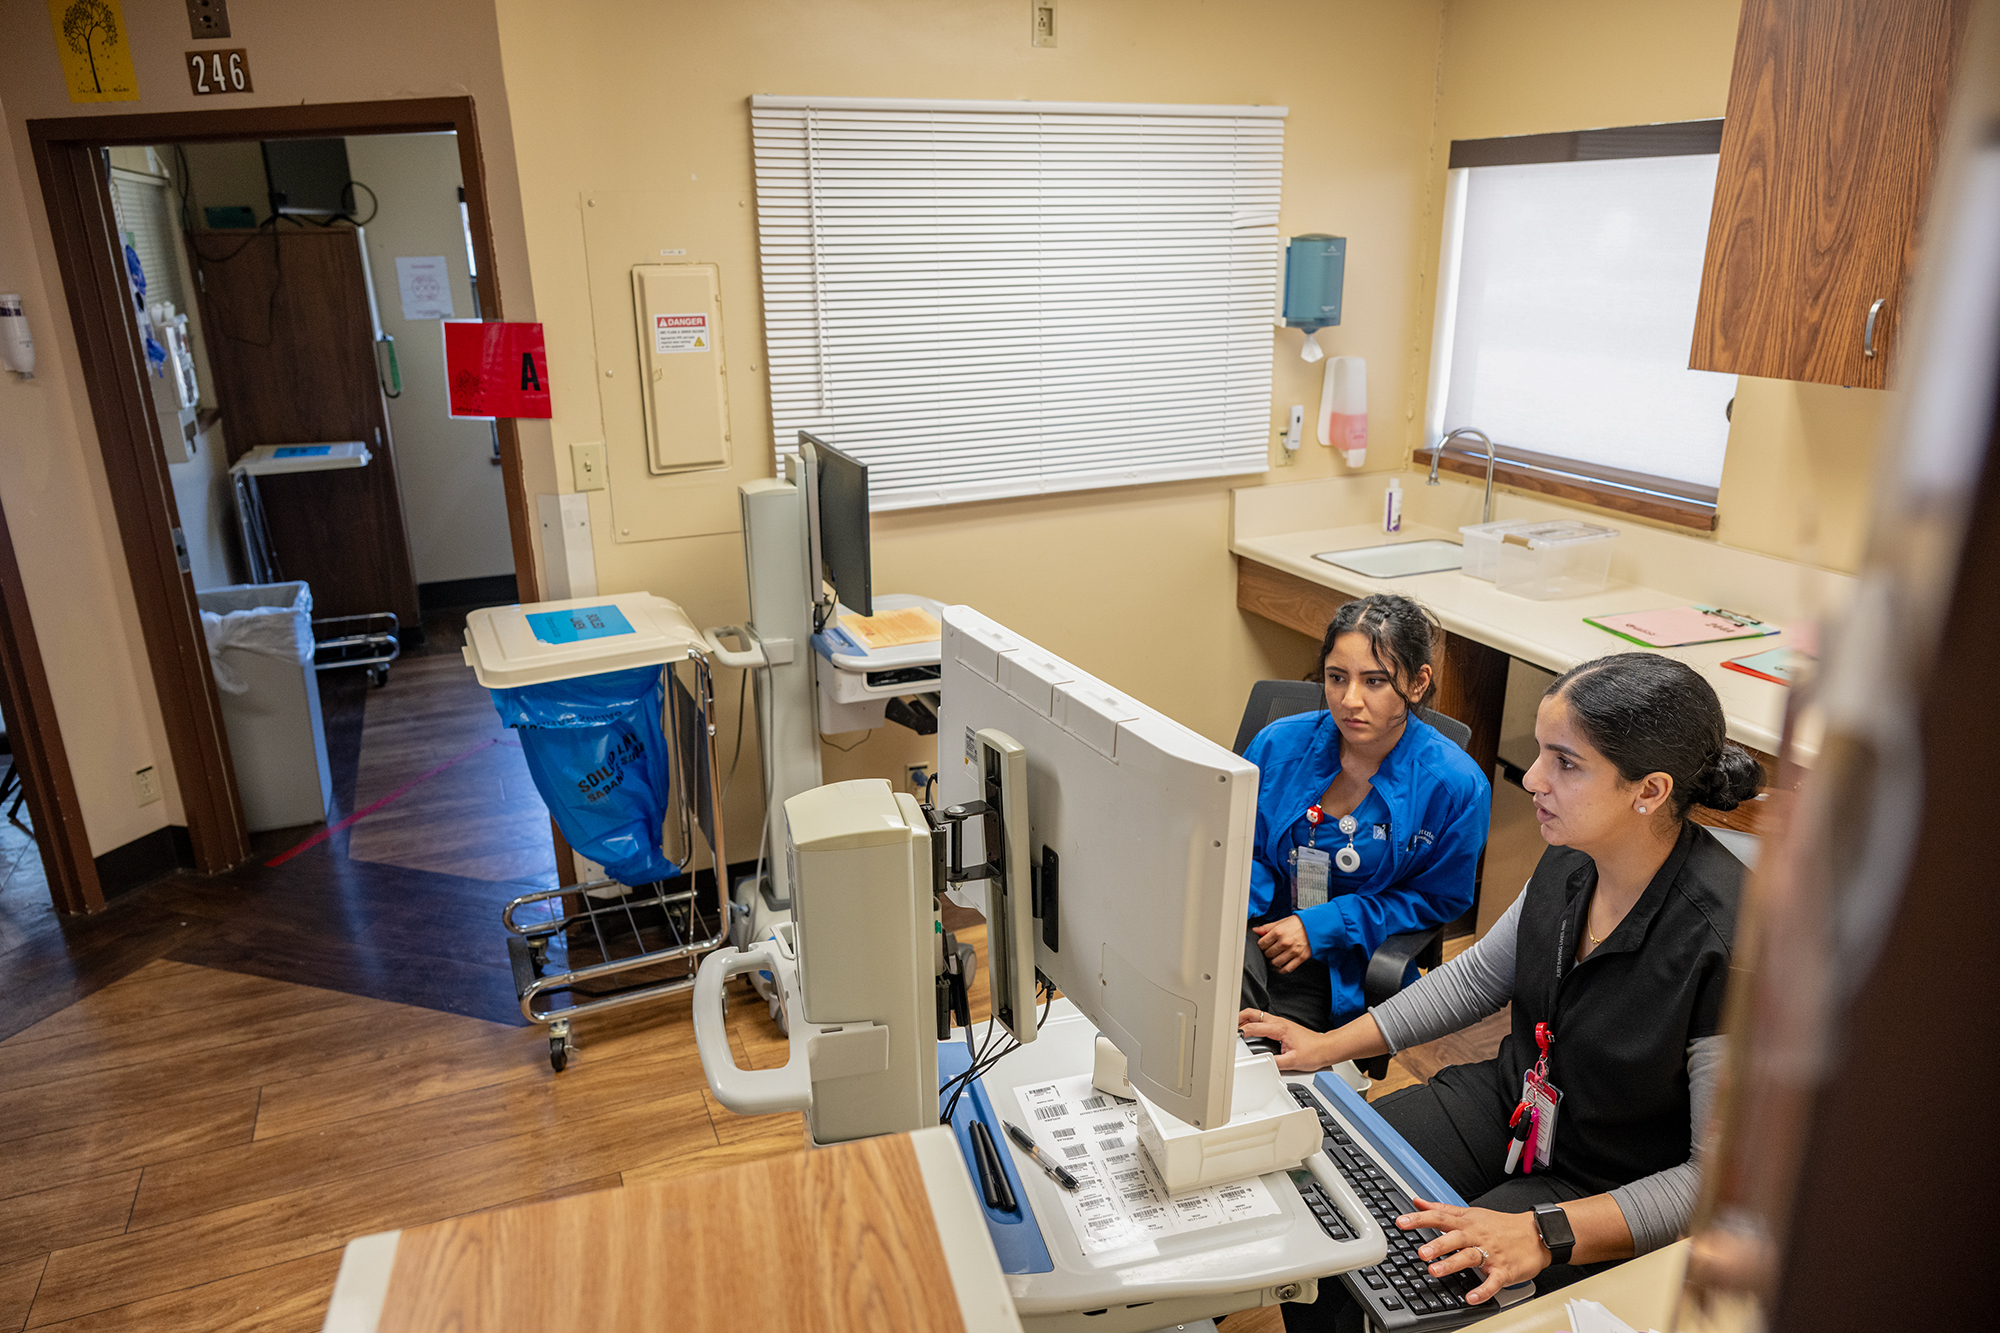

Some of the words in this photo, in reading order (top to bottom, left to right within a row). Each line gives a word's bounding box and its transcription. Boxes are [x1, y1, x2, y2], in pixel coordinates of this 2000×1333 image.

[192, 53, 245, 93] 246
[667, 317, 703, 326] DANGER
[521, 353, 541, 391] A
